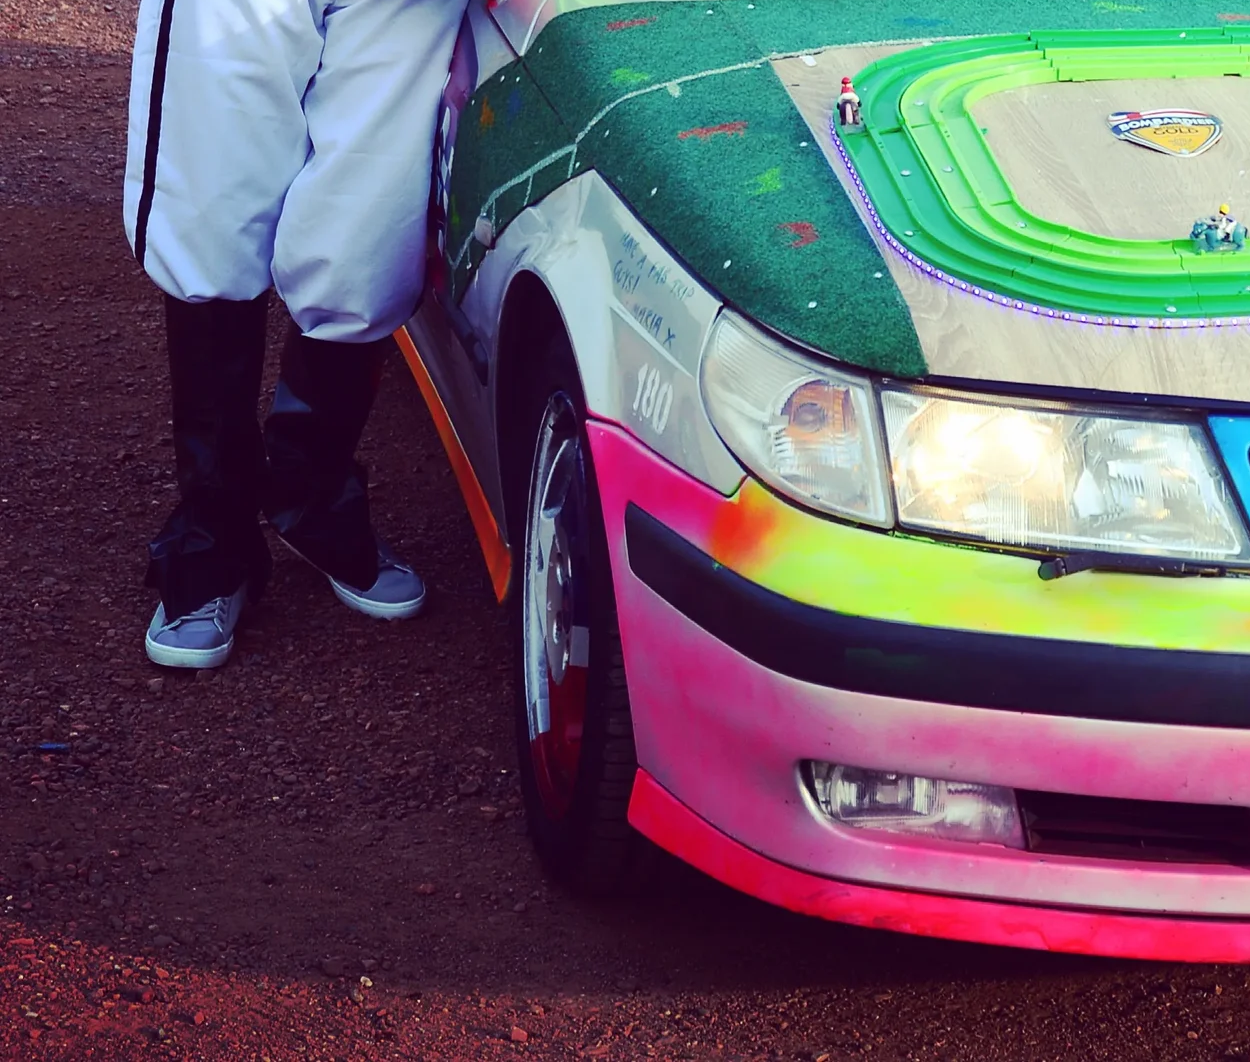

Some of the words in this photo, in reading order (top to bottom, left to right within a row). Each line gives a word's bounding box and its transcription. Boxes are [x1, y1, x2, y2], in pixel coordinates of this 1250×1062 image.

[1119, 117, 1217, 132] BOMBARDIER
[1153, 126, 1199, 136] GOLD
[632, 362, 674, 435] 180
